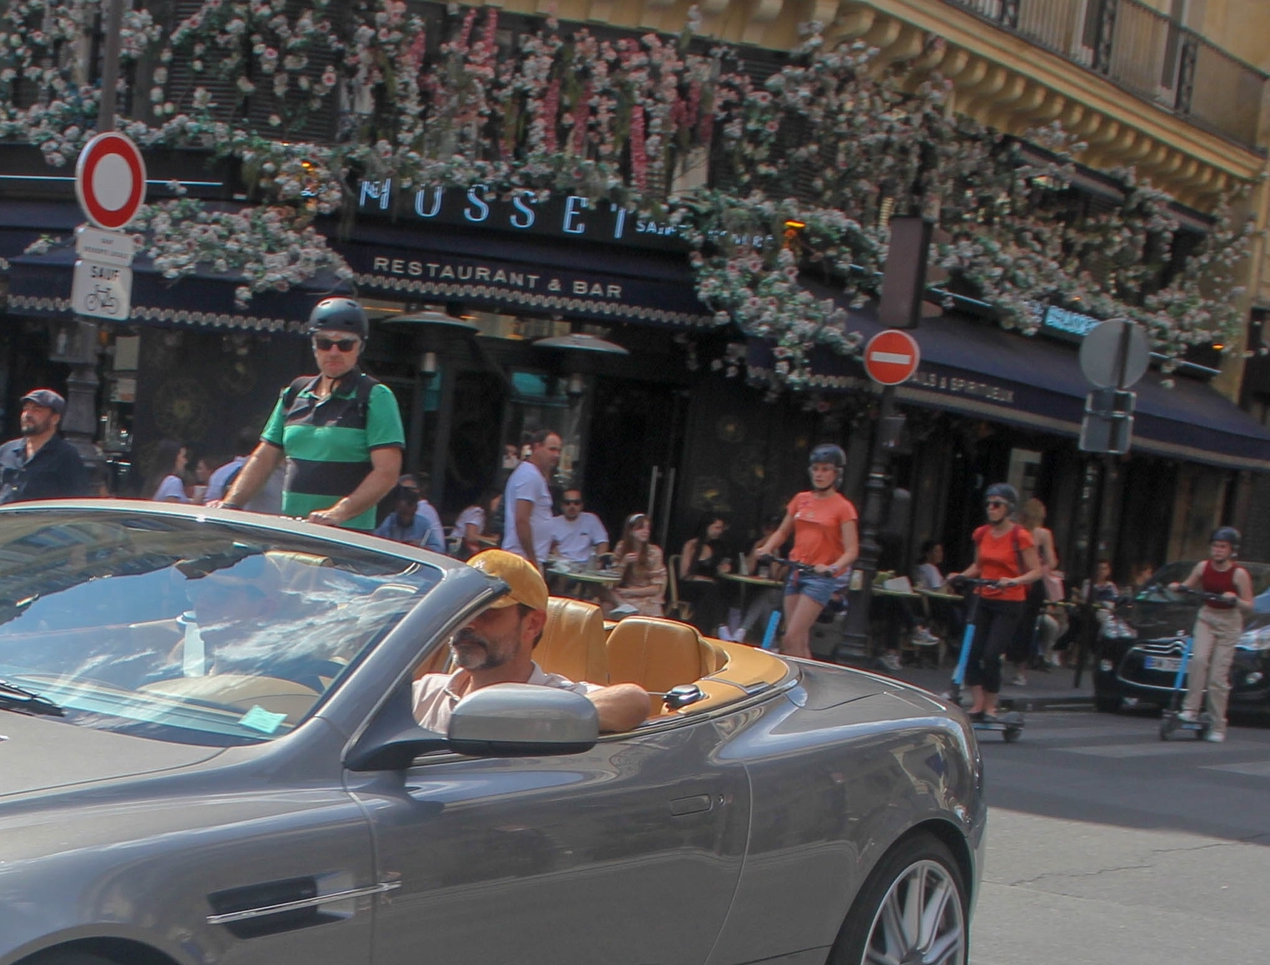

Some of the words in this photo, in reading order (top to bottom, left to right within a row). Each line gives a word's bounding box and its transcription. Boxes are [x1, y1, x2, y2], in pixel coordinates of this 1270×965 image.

[373, 257, 541, 289] RESTAURANT
[548, 279, 562, 291] &
[572, 281, 622, 298] BAR
